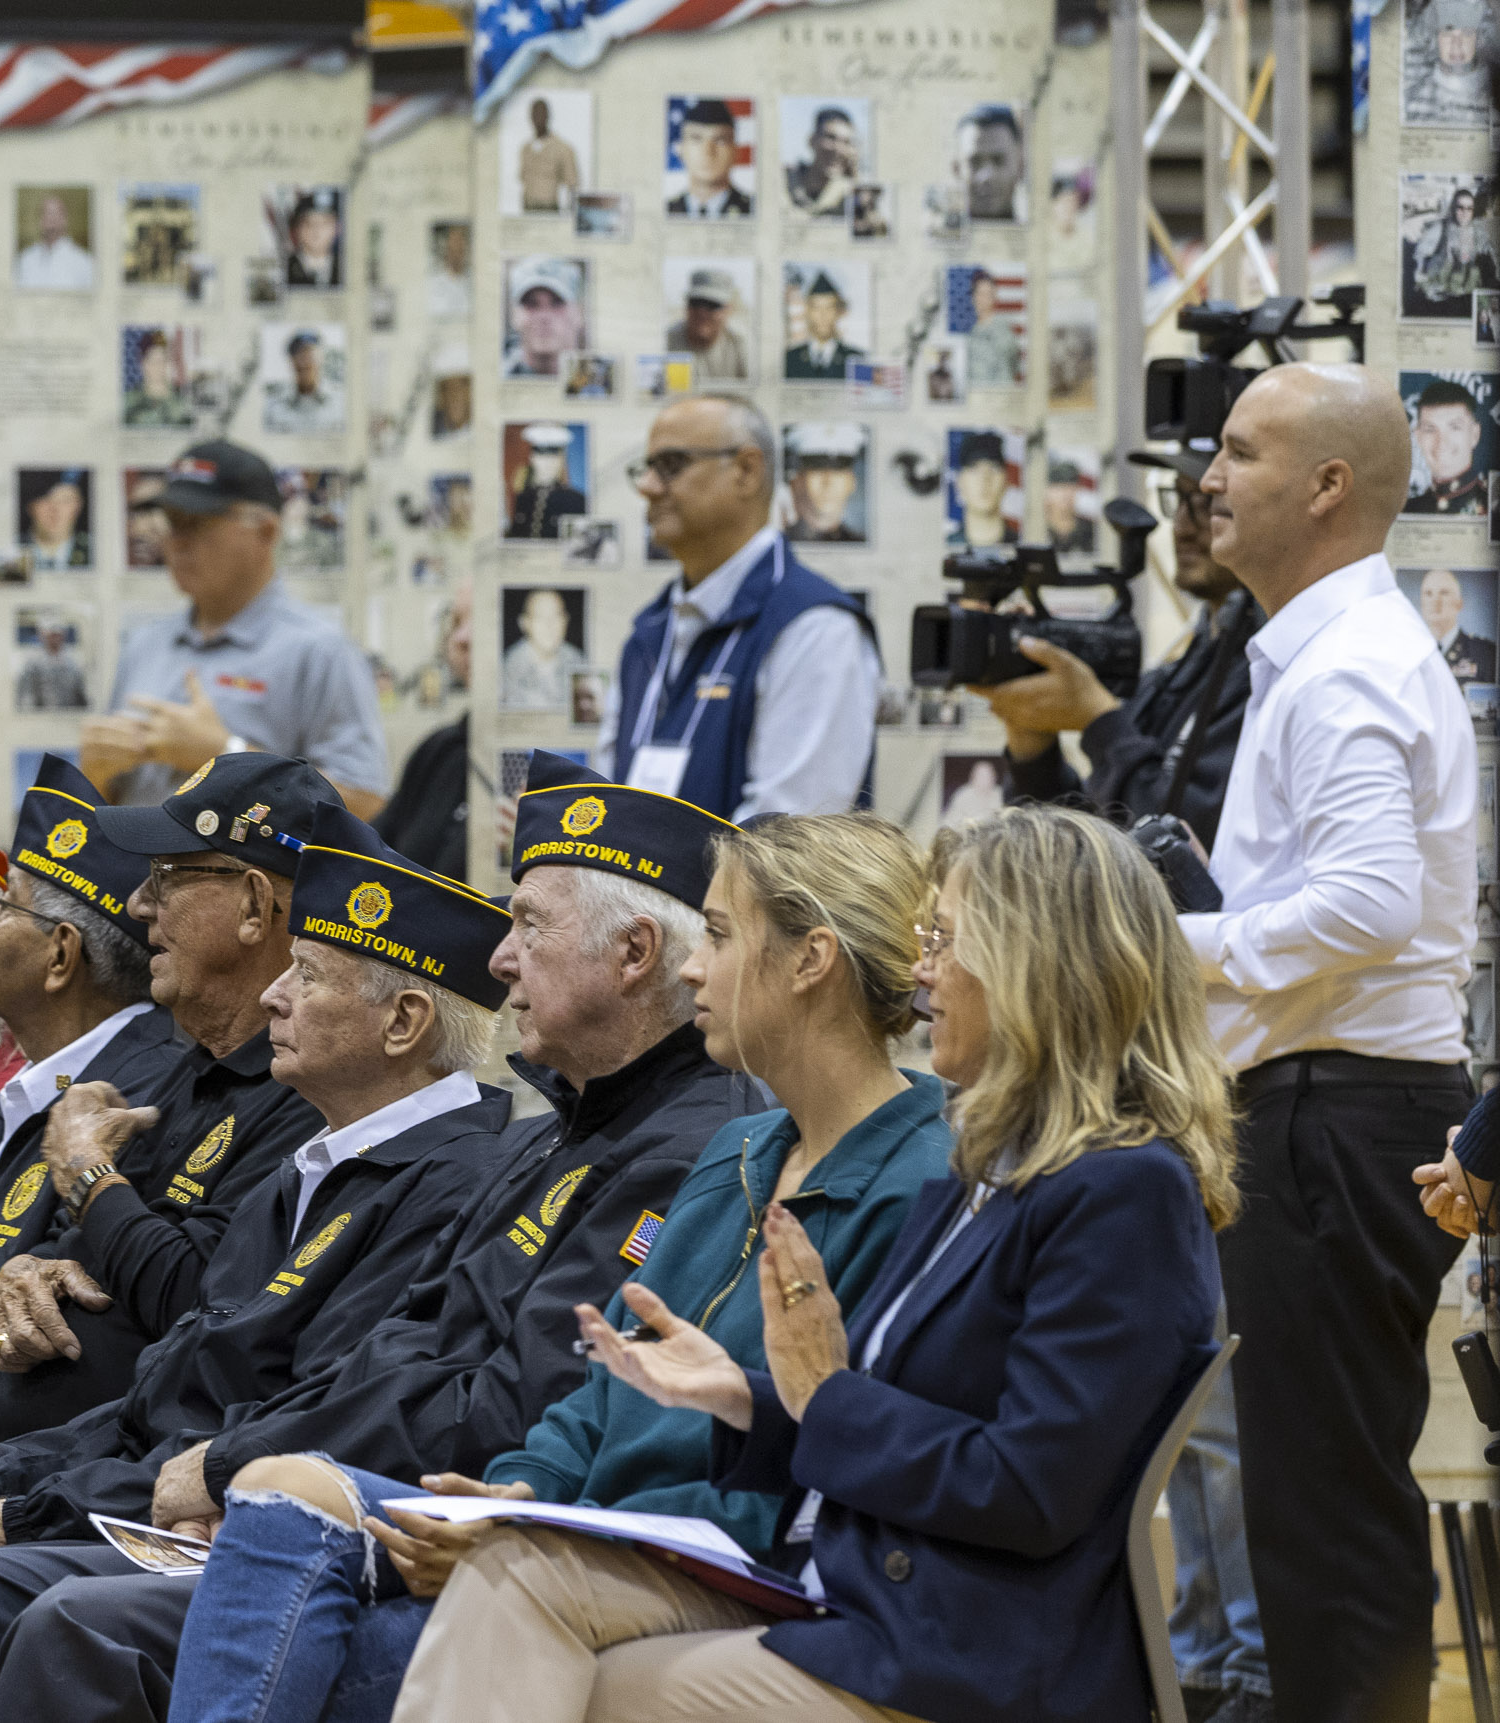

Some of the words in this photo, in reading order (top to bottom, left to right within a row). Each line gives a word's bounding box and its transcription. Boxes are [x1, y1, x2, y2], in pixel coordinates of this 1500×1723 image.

[637, 858, 664, 879] NJ
[99, 893, 124, 915] NJ
[303, 916, 417, 968] MORRISTOWN,
[421, 955, 446, 977] NJ
